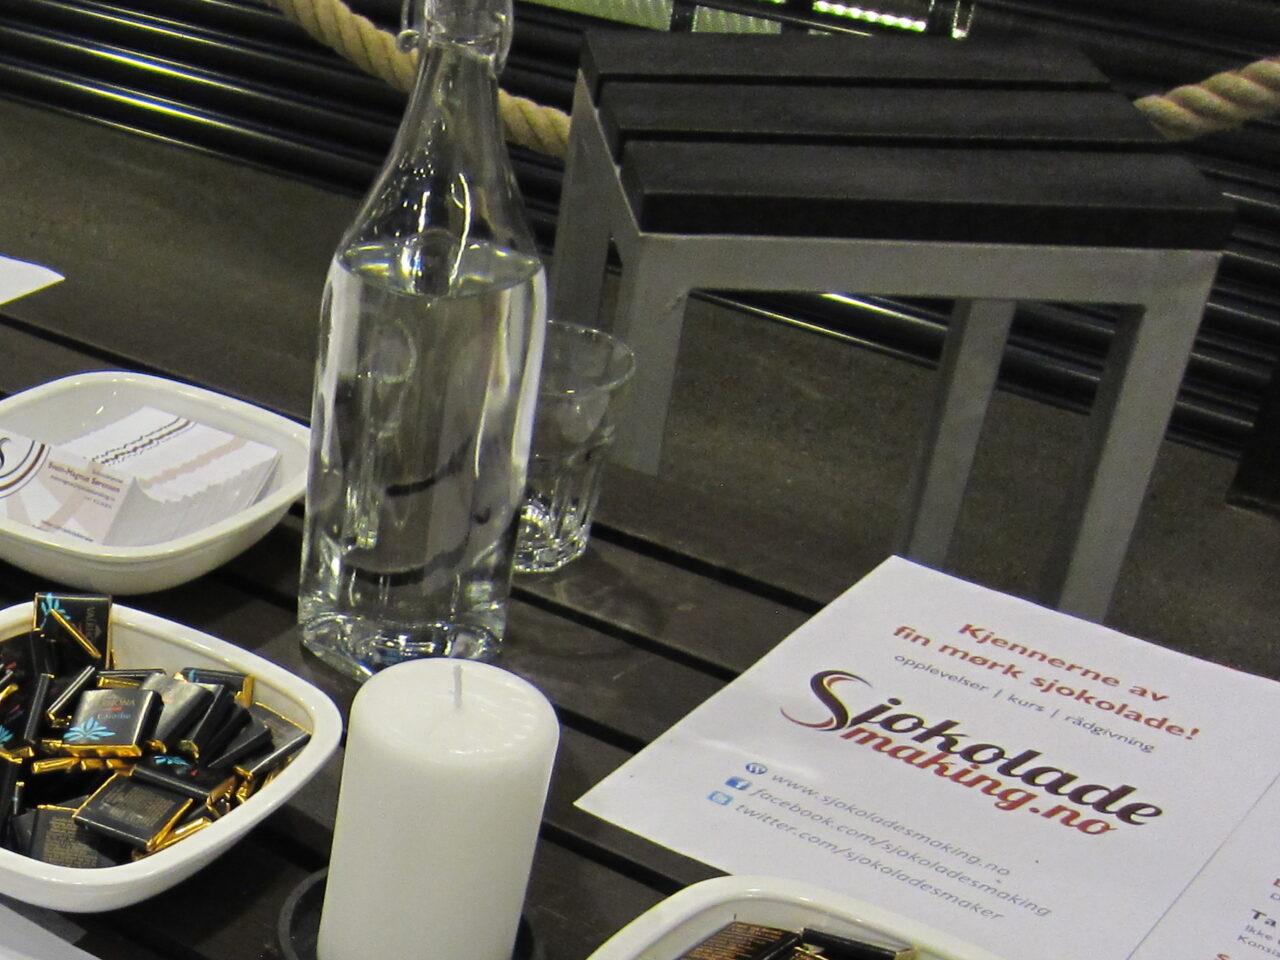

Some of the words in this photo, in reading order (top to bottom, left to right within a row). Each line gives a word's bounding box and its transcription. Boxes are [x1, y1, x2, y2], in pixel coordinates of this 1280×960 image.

[893, 625, 932, 646] fin
[938, 644, 1025, 680] mørk
[1030, 675, 1201, 740] sjokolade!
[894, 654, 989, 692] opplevelser
[1007, 694, 1045, 713] kurs
[1064, 713, 1156, 754] rådgivning
[958, 623, 1120, 688] Kjennerne
[1128, 684, 1170, 702] av
[780, 669, 1163, 826] Sjokolade
[841, 724, 1119, 837] making.no
[734, 804, 1006, 921] twitter.com/sjokoladesmaker
[748, 788, 1053, 918] facebook.com/sjokoladesmaking
[771, 773, 1011, 877] www.sjokoladesmaking.no
[1251, 909, 1277, 927] Ta
